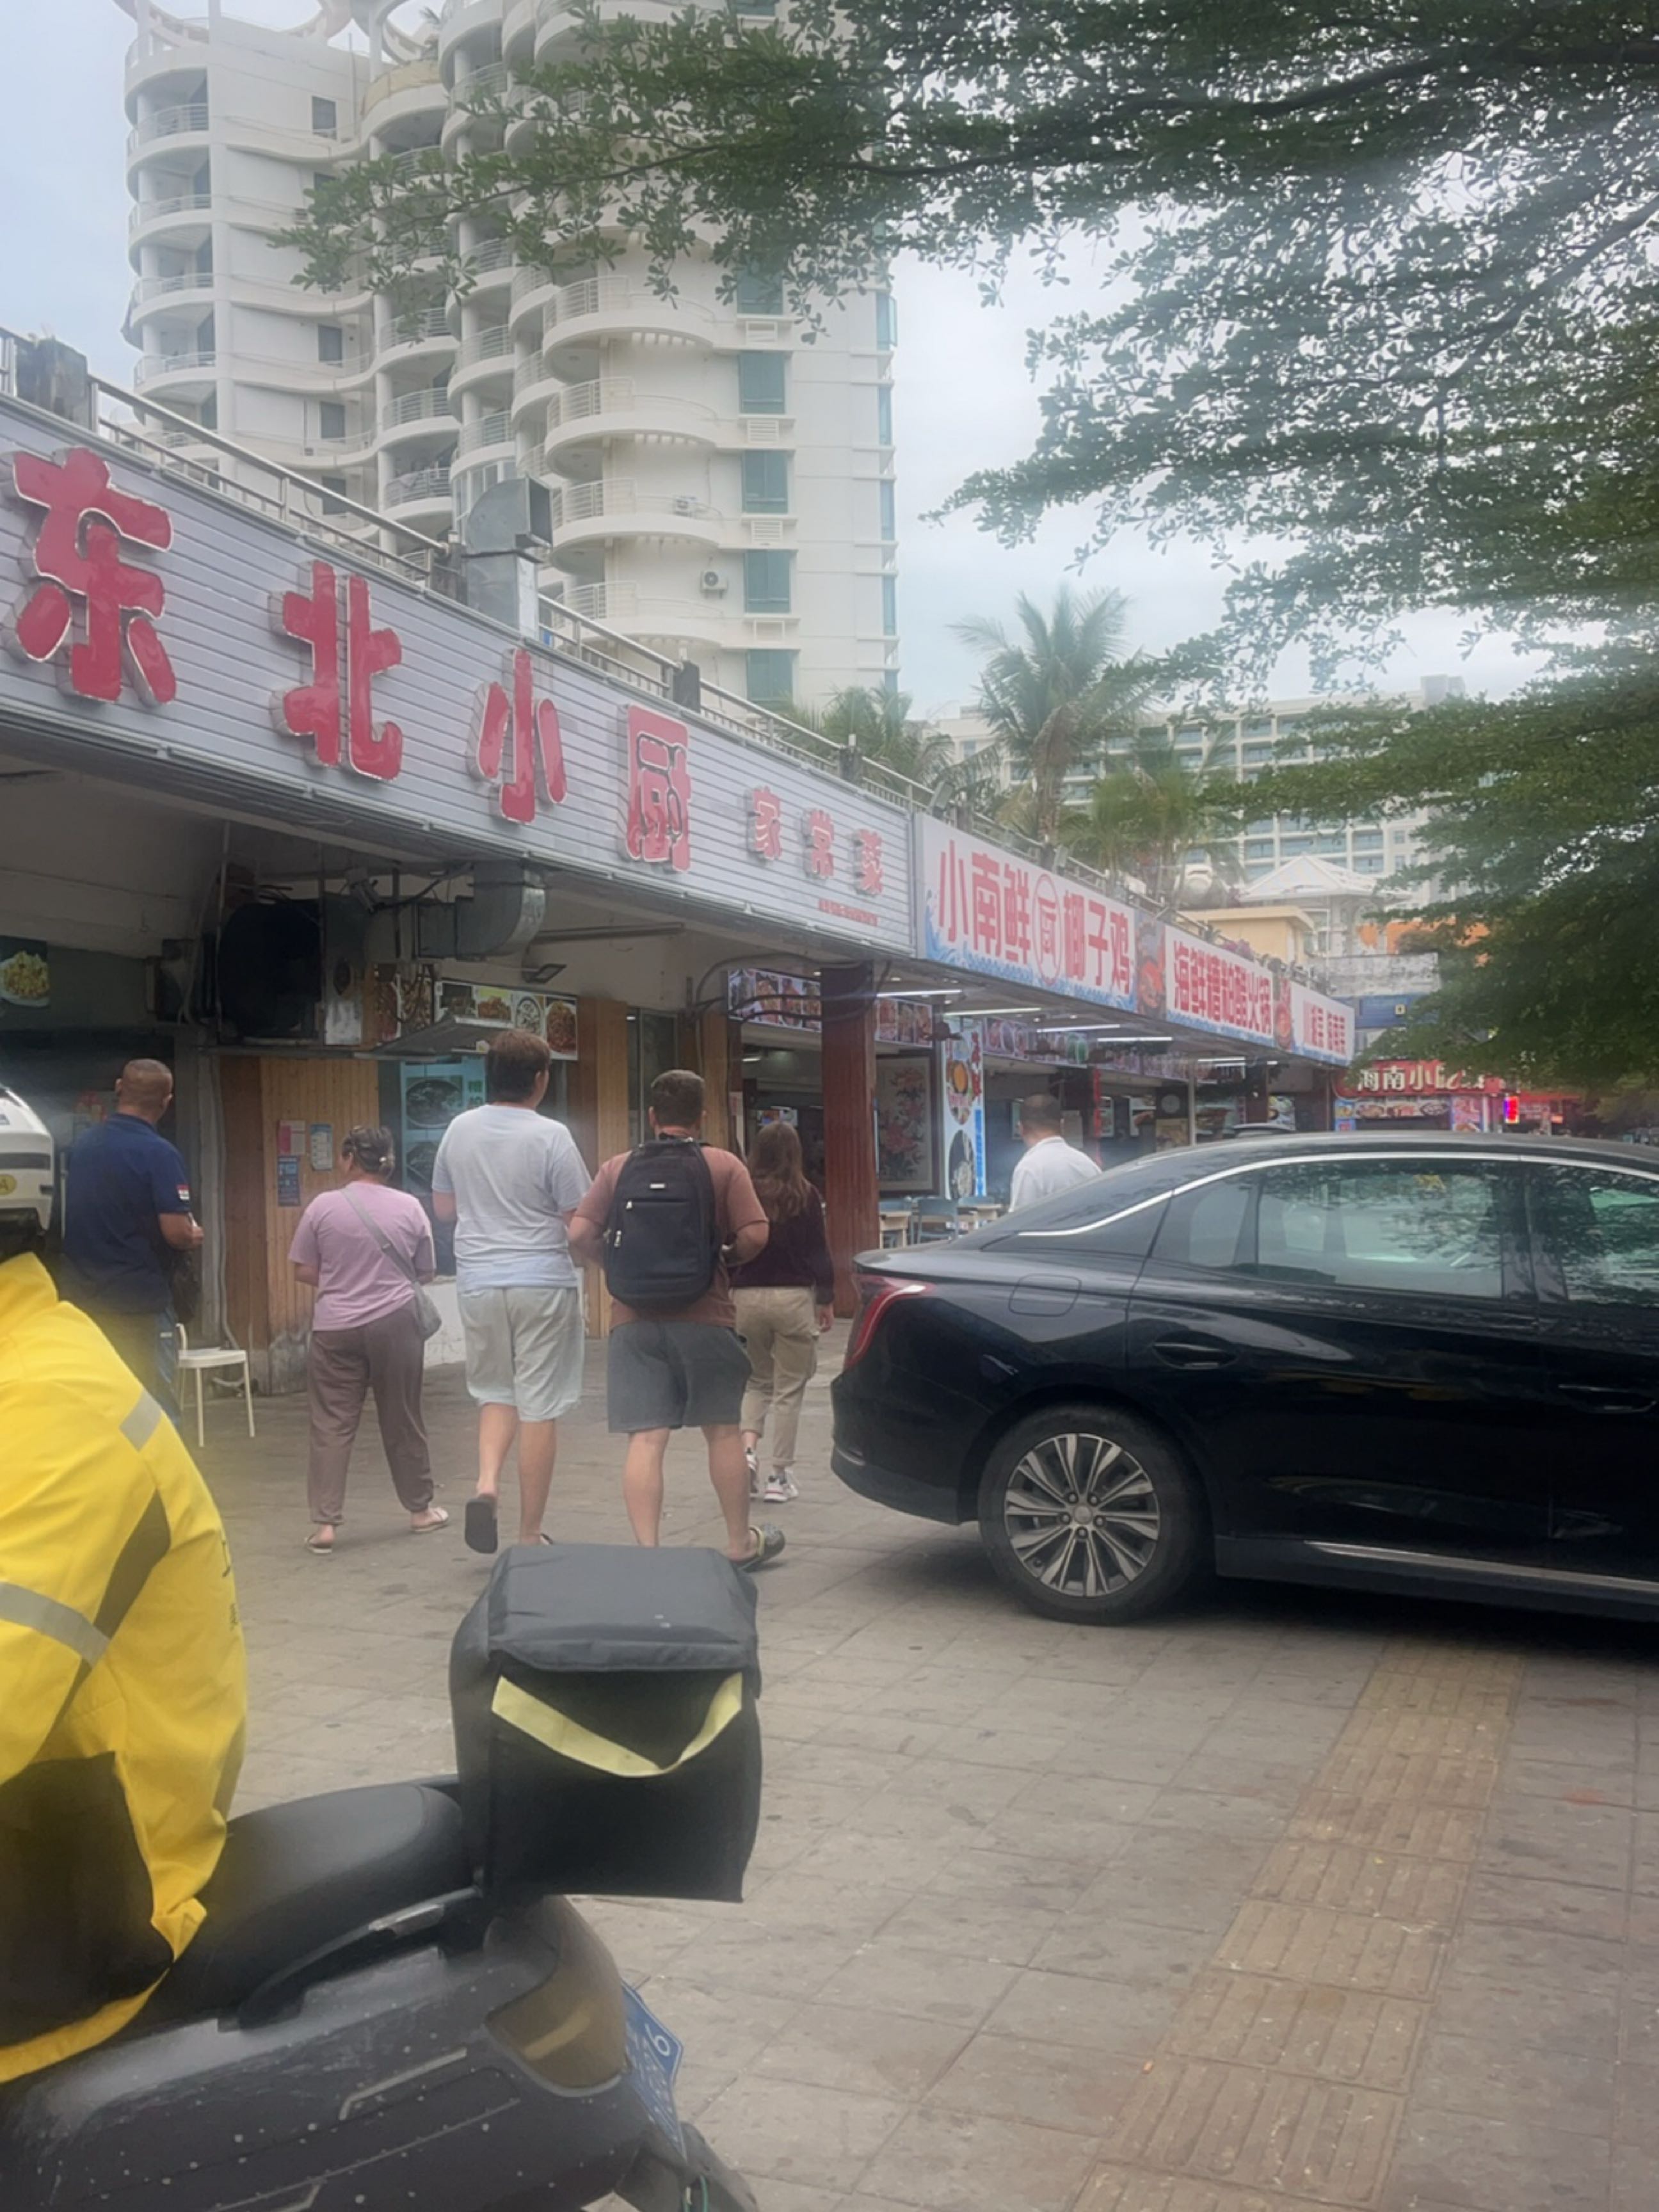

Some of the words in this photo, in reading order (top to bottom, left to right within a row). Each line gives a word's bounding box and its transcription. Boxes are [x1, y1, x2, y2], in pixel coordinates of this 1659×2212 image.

[12, 446, 693, 872] 东北小厨
[750, 785, 885, 895] 家常菜
